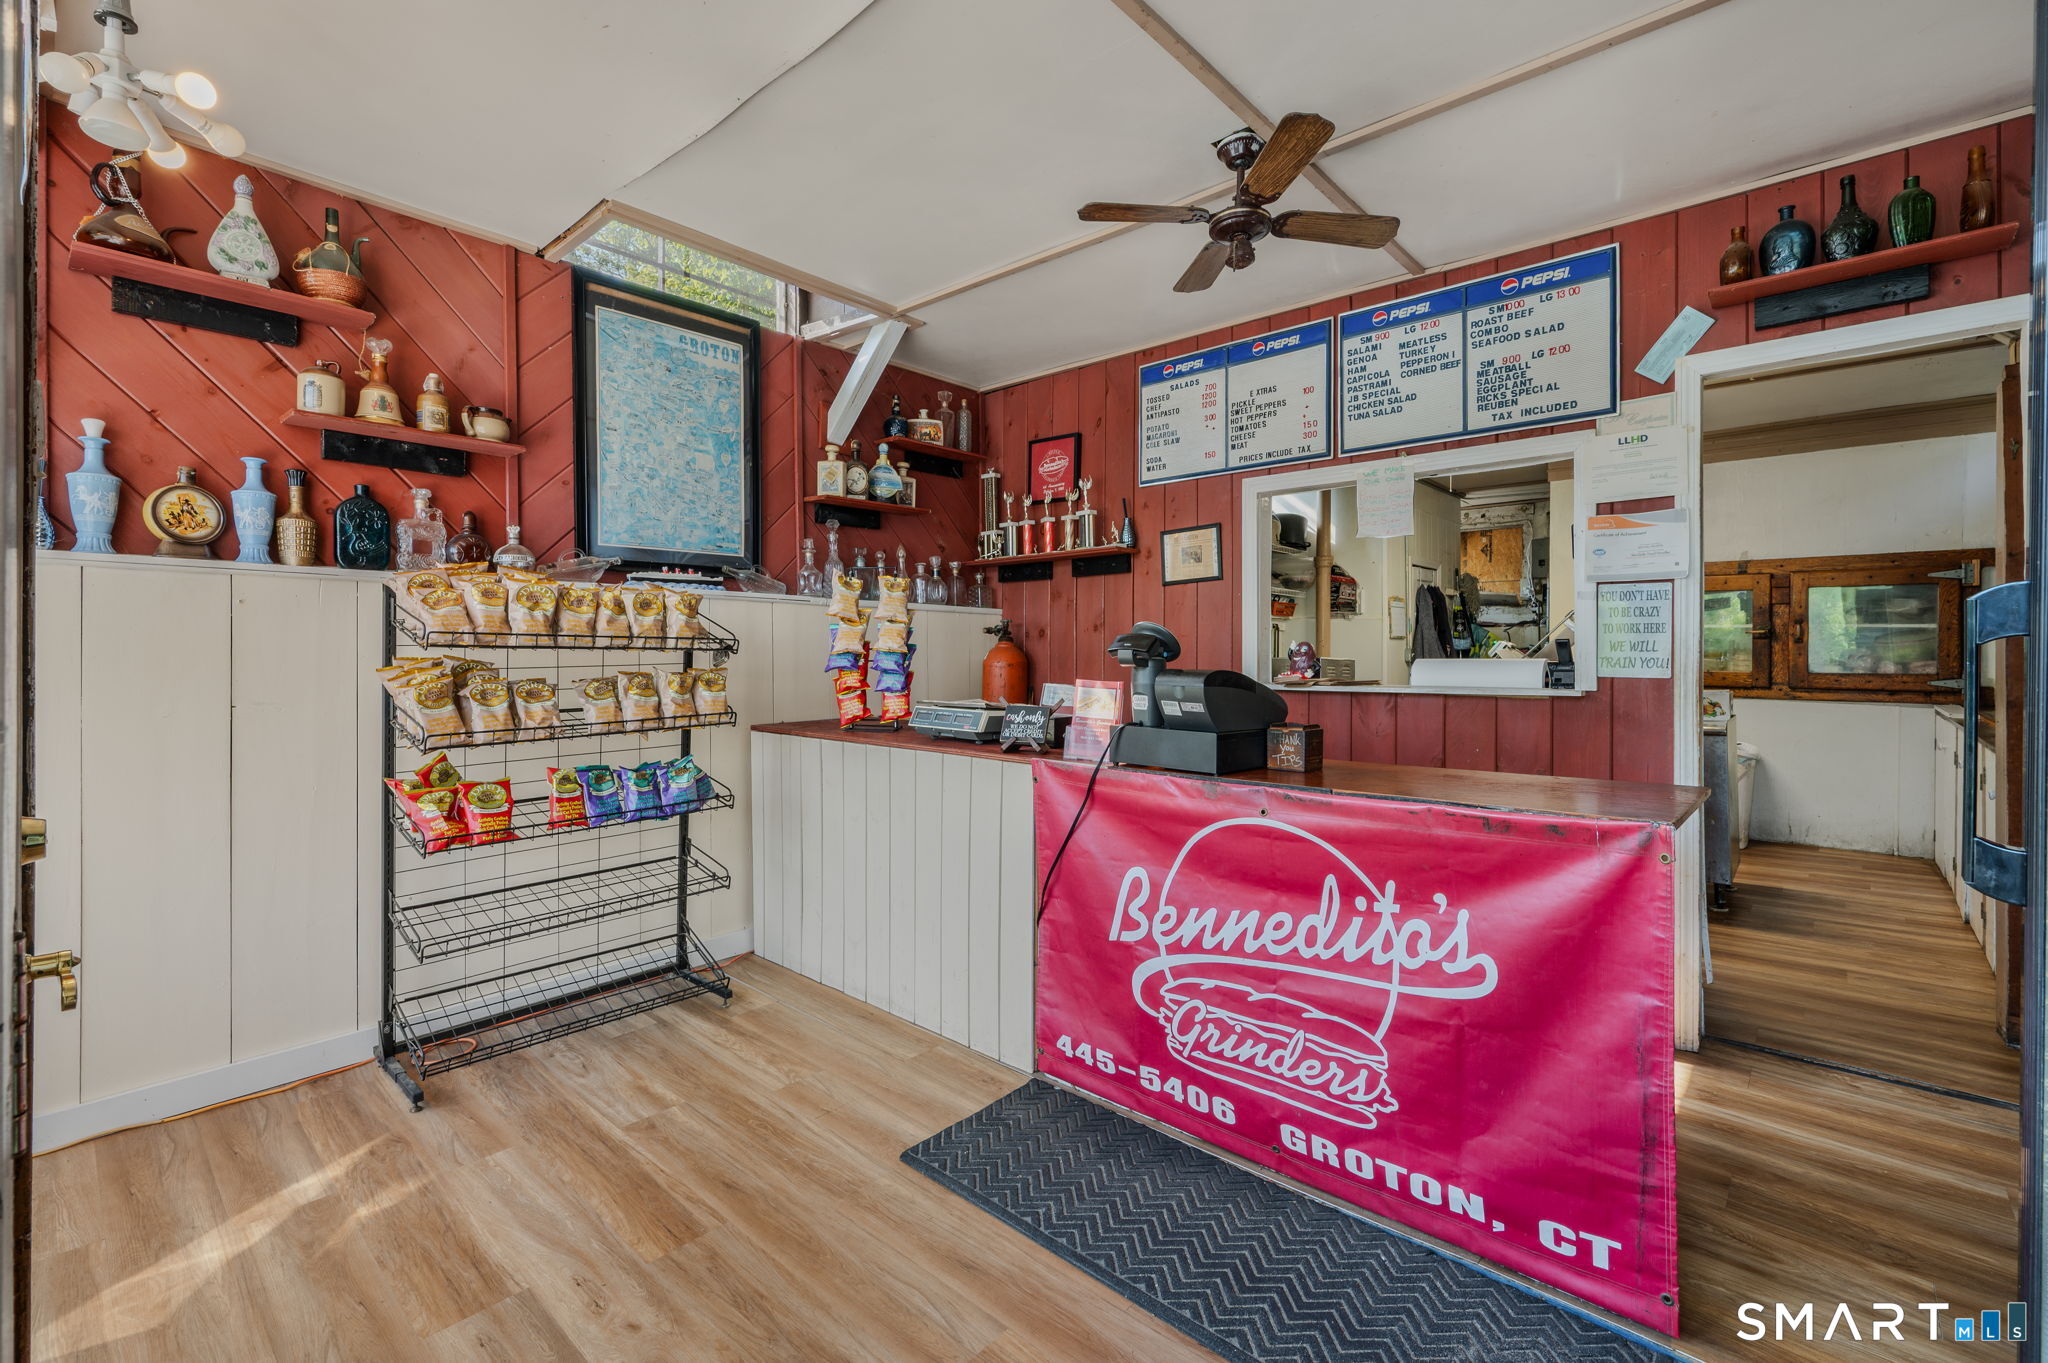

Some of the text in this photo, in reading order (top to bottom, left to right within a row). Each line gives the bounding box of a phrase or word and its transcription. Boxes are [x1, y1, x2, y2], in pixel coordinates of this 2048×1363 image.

[1521, 266, 1569, 289] PEPSI
[1539, 293, 1553, 304] LG
[1389, 302, 1430, 321] PEPSI
[1488, 305, 1504, 315] SM
[1470, 308, 1534, 330] ROAST BEEF
[1404, 325, 1416, 334] LG
[1470, 324, 1508, 339] COMBO
[1472, 322, 1565, 349] SEAFOOD SALAD
[1266, 335, 1300, 351] PEPSI
[1348, 332, 1448, 356] SALAMI MEATLESS
[1360, 336, 1372, 344] SM
[678, 334, 740, 364] GROTON
[1346, 345, 1436, 366] GENOA TURKEY
[1532, 350, 1544, 359] LG
[1175, 359, 1204, 374] PEPSI
[1480, 354, 1520, 369] SM 900
[1346, 359, 1462, 384] CAPICOLA CORNED BEEF
[1348, 365, 1366, 376] HAM
[1476, 362, 1531, 378] MEATBALL
[1170, 379, 1200, 392] SALADS
[1348, 378, 1392, 394] PASTRAMI
[1476, 371, 1526, 386] SAUSAGE
[1477, 378, 1534, 395] EGGPLANT
[1146, 392, 1216, 404] TOSSED 1200
[1348, 387, 1401, 403] JB SPECIAL
[1348, 393, 1416, 412] CHICKEN SALAD
[1476, 392, 1506, 404] RICKS
[1146, 400, 1216, 412] CHEF 1200
[1230, 400, 1286, 416] SWEET PEPPERS
[1232, 398, 1256, 409] PICKLE
[1478, 398, 1518, 412] REUBEN
[1492, 400, 1578, 422] TAX INCLUDED
[1146, 408, 1180, 420] ANTIPASTO
[1230, 410, 1277, 425] HOT PEPPERS
[1348, 406, 1402, 422] TUNA SALAD
[1146, 414, 1216, 433] POTATO 300
[1231, 420, 1318, 433] TOMATOES 150
[1146, 430, 1178, 441] MACARONI
[1146, 437, 1180, 449] COLE SLAW
[1231, 431, 1318, 442] CHEESE 300
[1618, 434, 1648, 445] LLHD
[1231, 442, 1248, 450] MEAT
[1239, 444, 1312, 463] PRICES INCLUDE TAX
[1204, 451, 1216, 459] 150
[1146, 464, 1166, 472] WATER
[1600, 590, 1670, 602] YOU DON'T HAVE
[1608, 606, 1661, 618] TO BE CRAZY
[1602, 622, 1666, 634] TO WORK HERE
[1609, 640, 1658, 652] WE WILL
[1600, 657, 1670, 668] TRAIN YOU!
[1006, 710, 1046, 726] cash only
[1270, 731, 1302, 746] THANK
[1272, 754, 1302, 767] TIPS
[470, 784, 506, 796] DIRTY
[1108, 866, 1492, 980] Bennedito's
[1171, 998, 1386, 1104] Grinders
[1056, 1034, 1623, 1272] 445-5406 GROTON, CT
